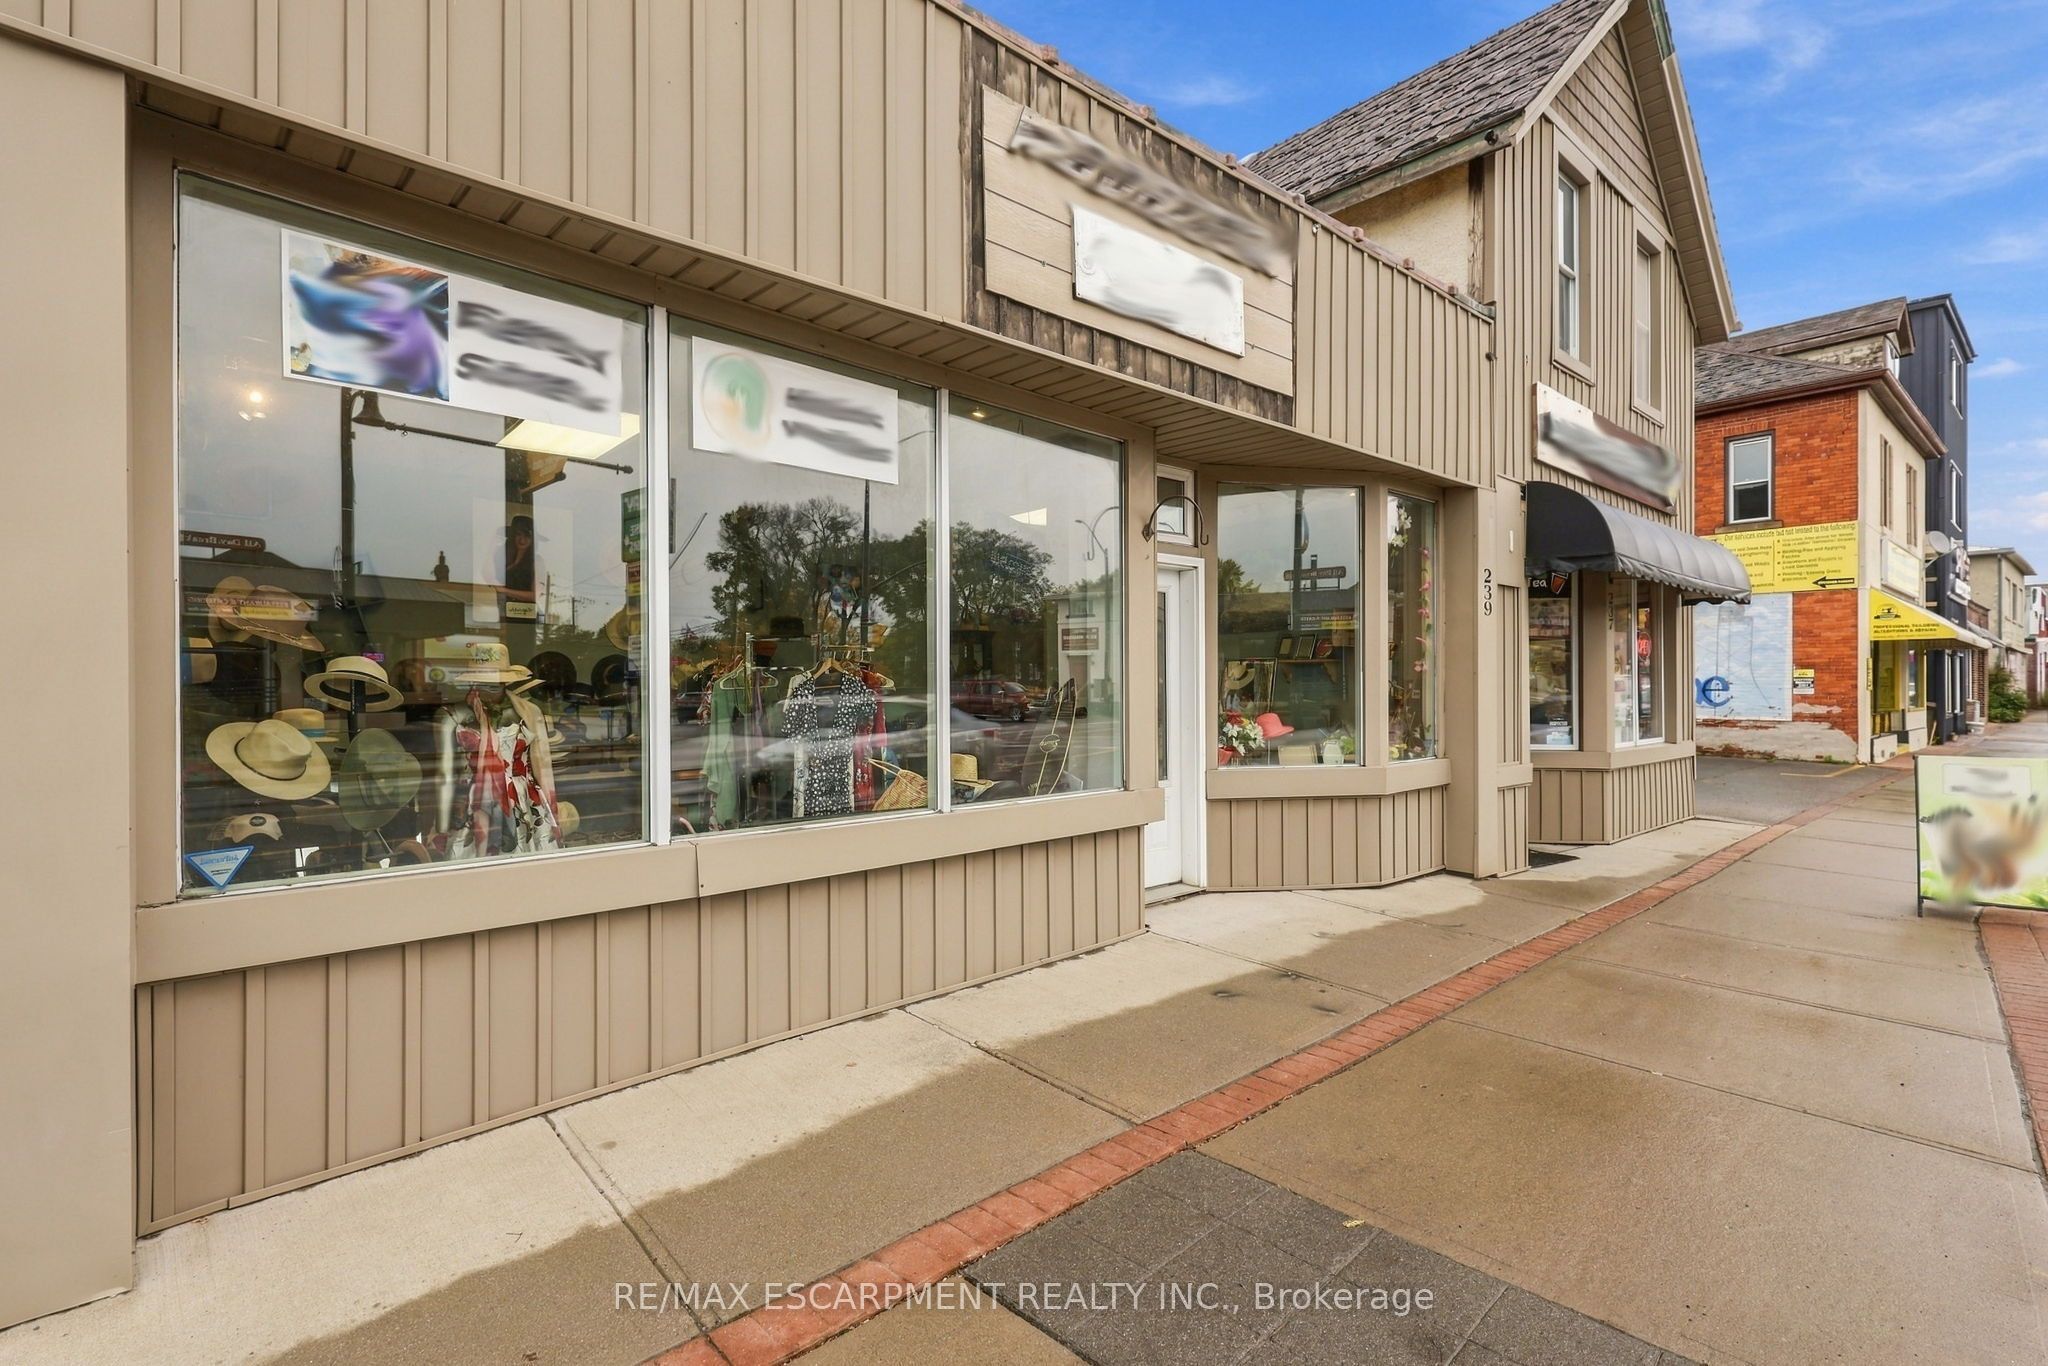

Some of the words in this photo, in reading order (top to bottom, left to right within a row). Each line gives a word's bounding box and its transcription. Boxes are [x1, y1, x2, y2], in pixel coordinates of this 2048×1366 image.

[1724, 534, 1733, 542] Our
[1735, 532, 1755, 540] services
[1483, 568, 1492, 616] 239
